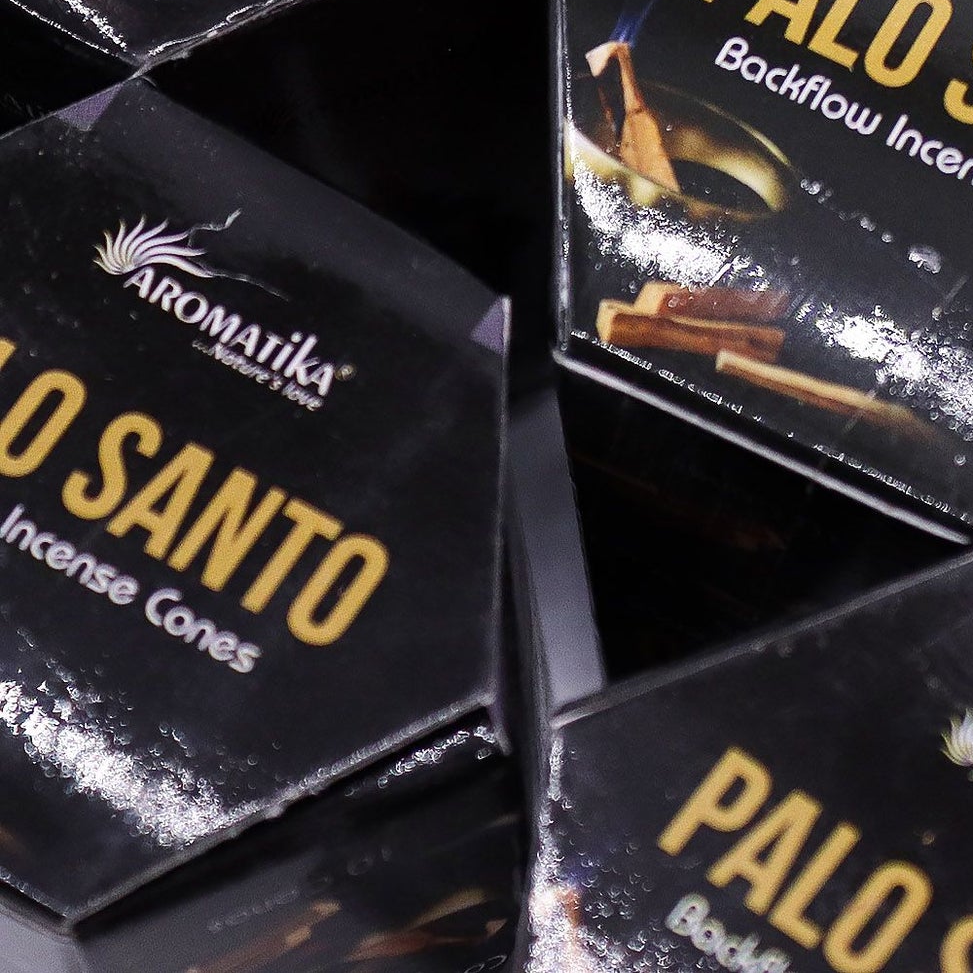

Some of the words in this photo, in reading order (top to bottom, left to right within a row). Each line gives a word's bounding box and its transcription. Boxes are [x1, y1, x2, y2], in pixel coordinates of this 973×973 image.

[714, 36, 881, 136] Backflow
[0, 503, 139, 605] Incense
[145, 587, 262, 673] Cones
[62, 412, 390, 646] SANTO
[657, 747, 933, 973] PALO
